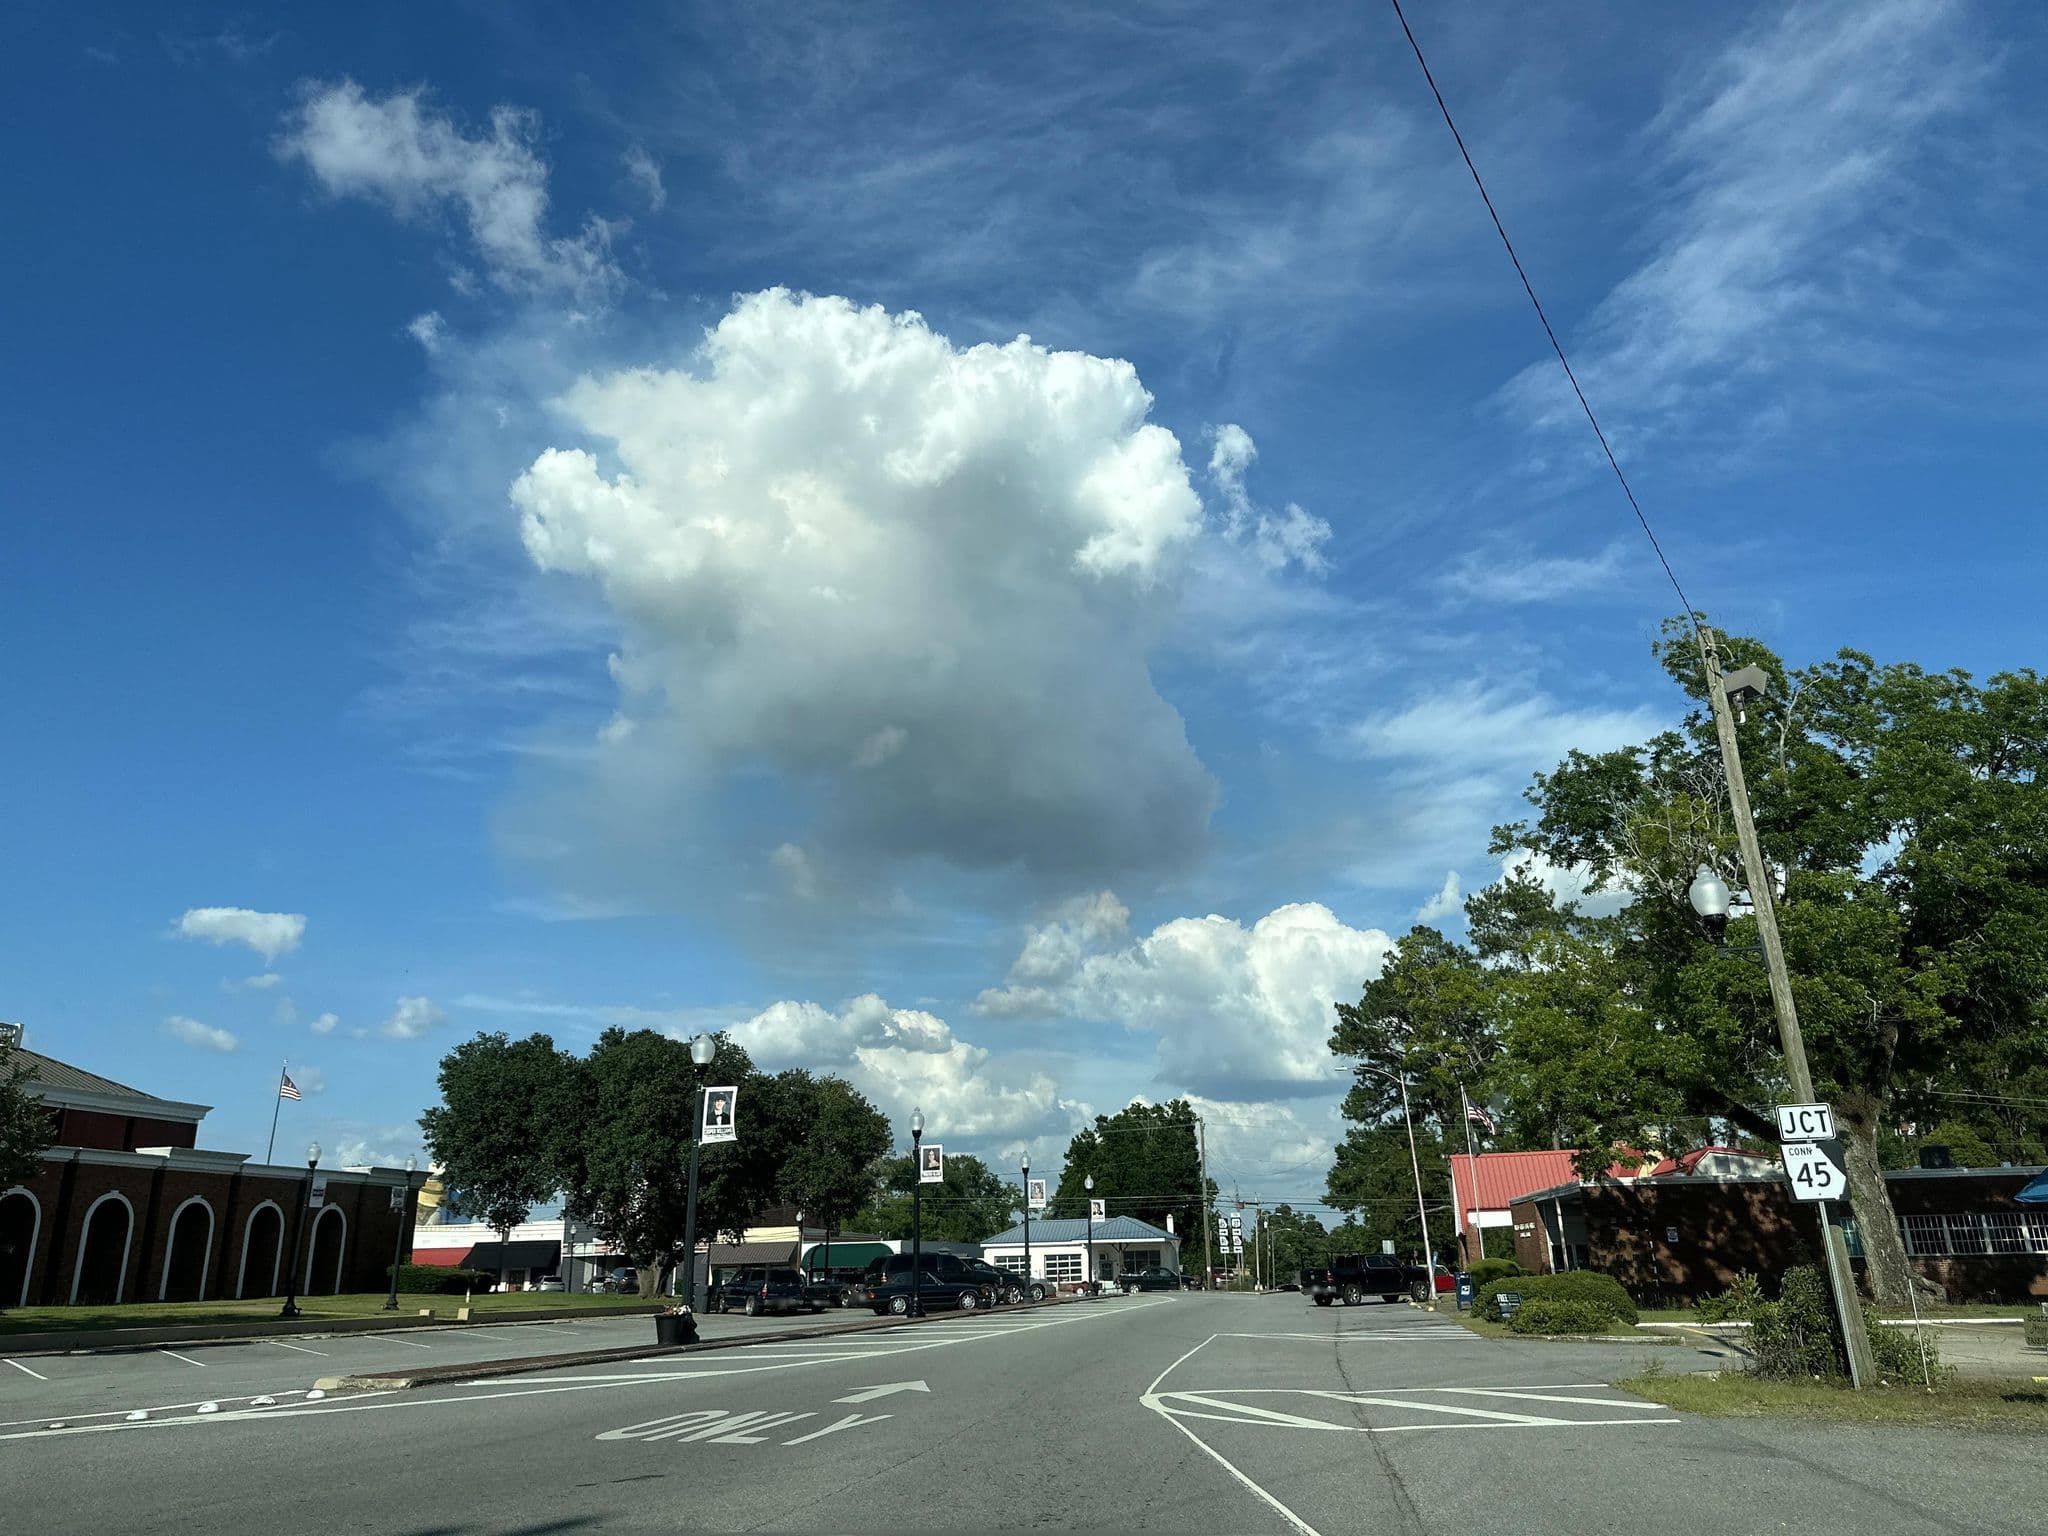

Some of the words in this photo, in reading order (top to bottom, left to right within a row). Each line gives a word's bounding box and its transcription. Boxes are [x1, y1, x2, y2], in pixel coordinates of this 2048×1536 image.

[1784, 1110, 1827, 1134] JCT
[1788, 1147, 1813, 1156] CONN
[1797, 1162, 1831, 1187] 45
[1497, 1294, 1509, 1302] FREE
[595, 1410, 894, 1446] ONLY
